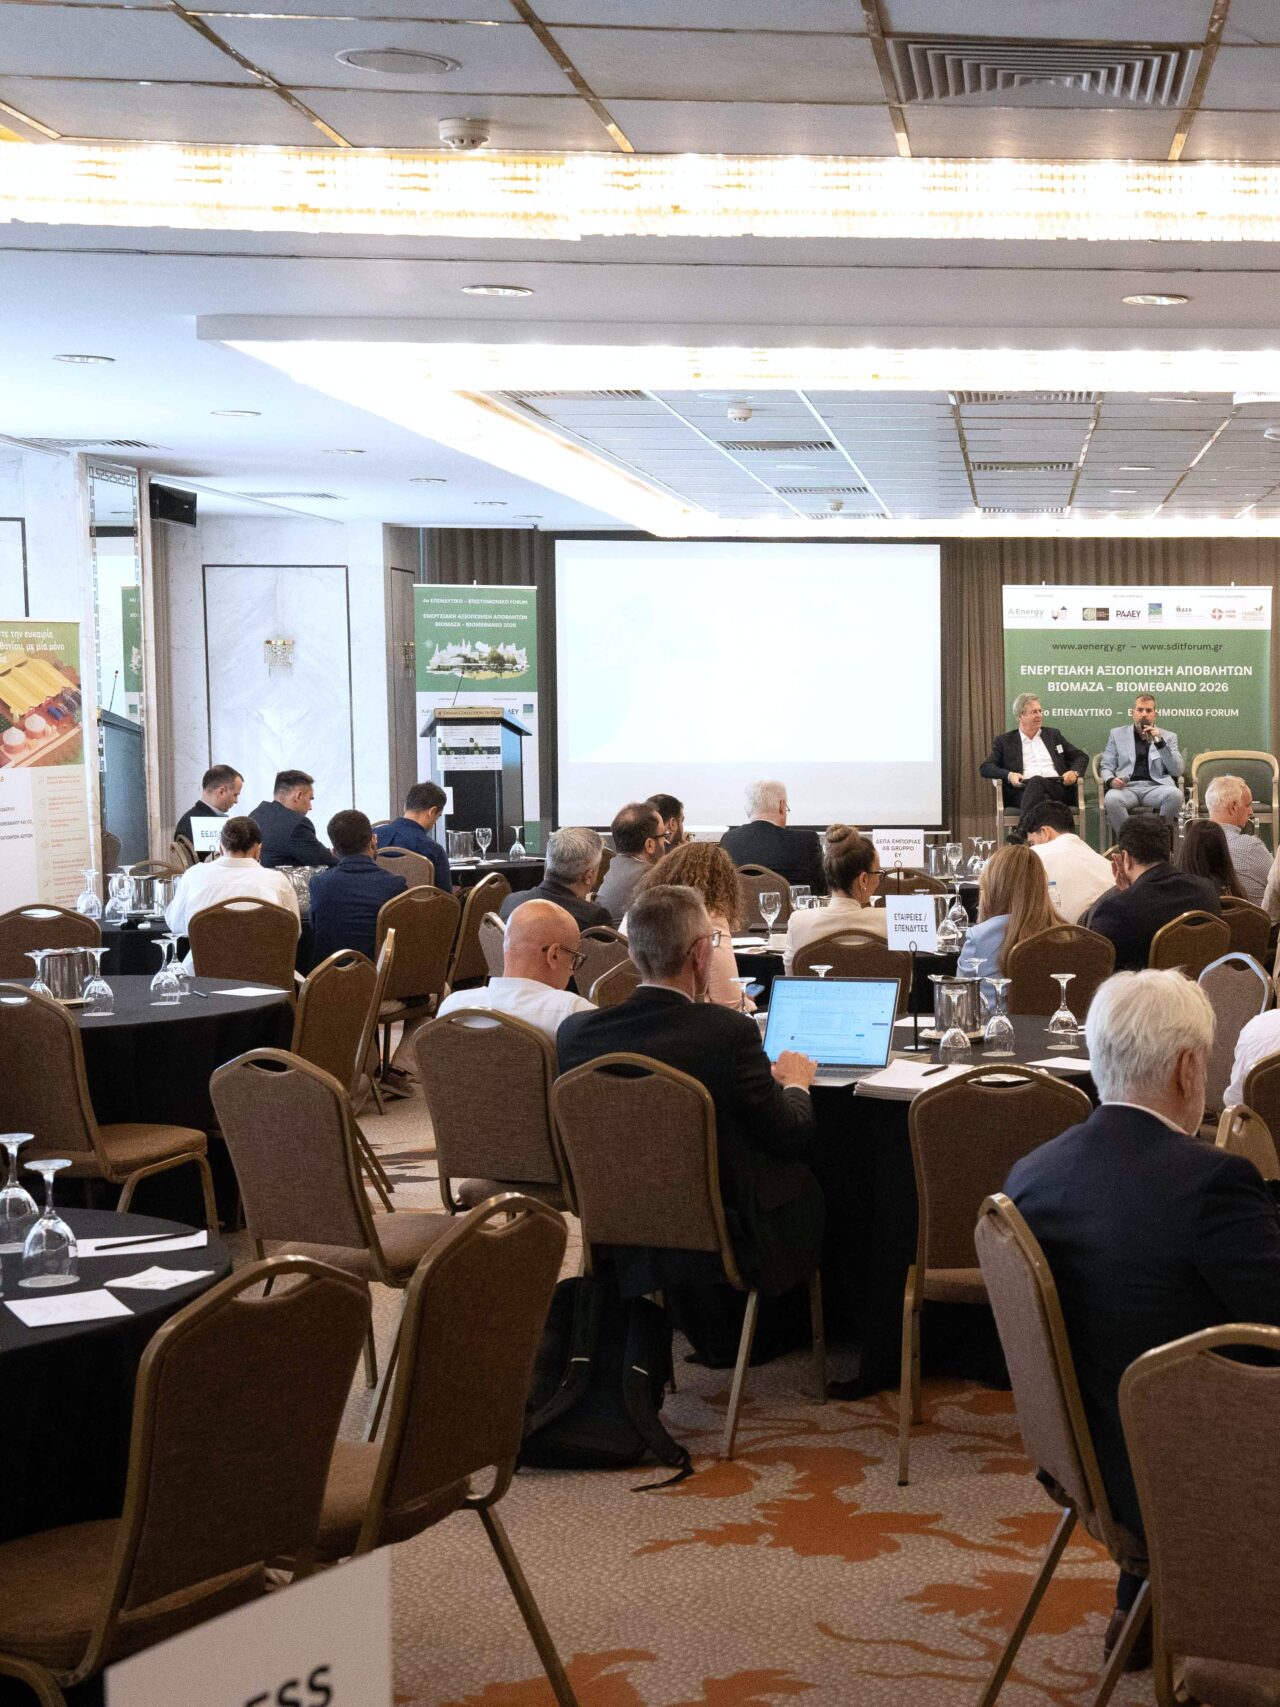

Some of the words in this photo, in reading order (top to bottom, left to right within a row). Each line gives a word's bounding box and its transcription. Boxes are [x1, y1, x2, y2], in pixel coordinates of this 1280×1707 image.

[1052, 644, 1126, 652] www.aenergy.gr
[1141, 642, 1223, 652] www.sditforum.gr
[1020, 665, 1093, 676] ΕΝΕΡΓΕΙΑΚΗ
[1096, 665, 1173, 676] ΑΞΙΟΠΟΙΗΣΗ
[1176, 666, 1252, 676] ΑΠΟΒΛΗΤΩΝ
[1047, 682, 1104, 692] ΒΙΟΜΑΖΑ
[1116, 682, 1197, 692] ΒΙΟΜΕΘΑΝΙΟ
[1200, 682, 1229, 692] 2026
[1052, 708, 1112, 716] ΕΠΕΝΔΥΤΙΚΟ
[1128, 708, 1203, 716] ΕΗΜΟΝΙΚΟ
[1206, 709, 1239, 717] FORUM
[894, 913, 922, 921] ΕΤΑΙΡΕΙΕΣ
[894, 924, 928, 932] ΕΠΕΝΔΥΤΕΣ
[245, 1664, 332, 1707] SS
